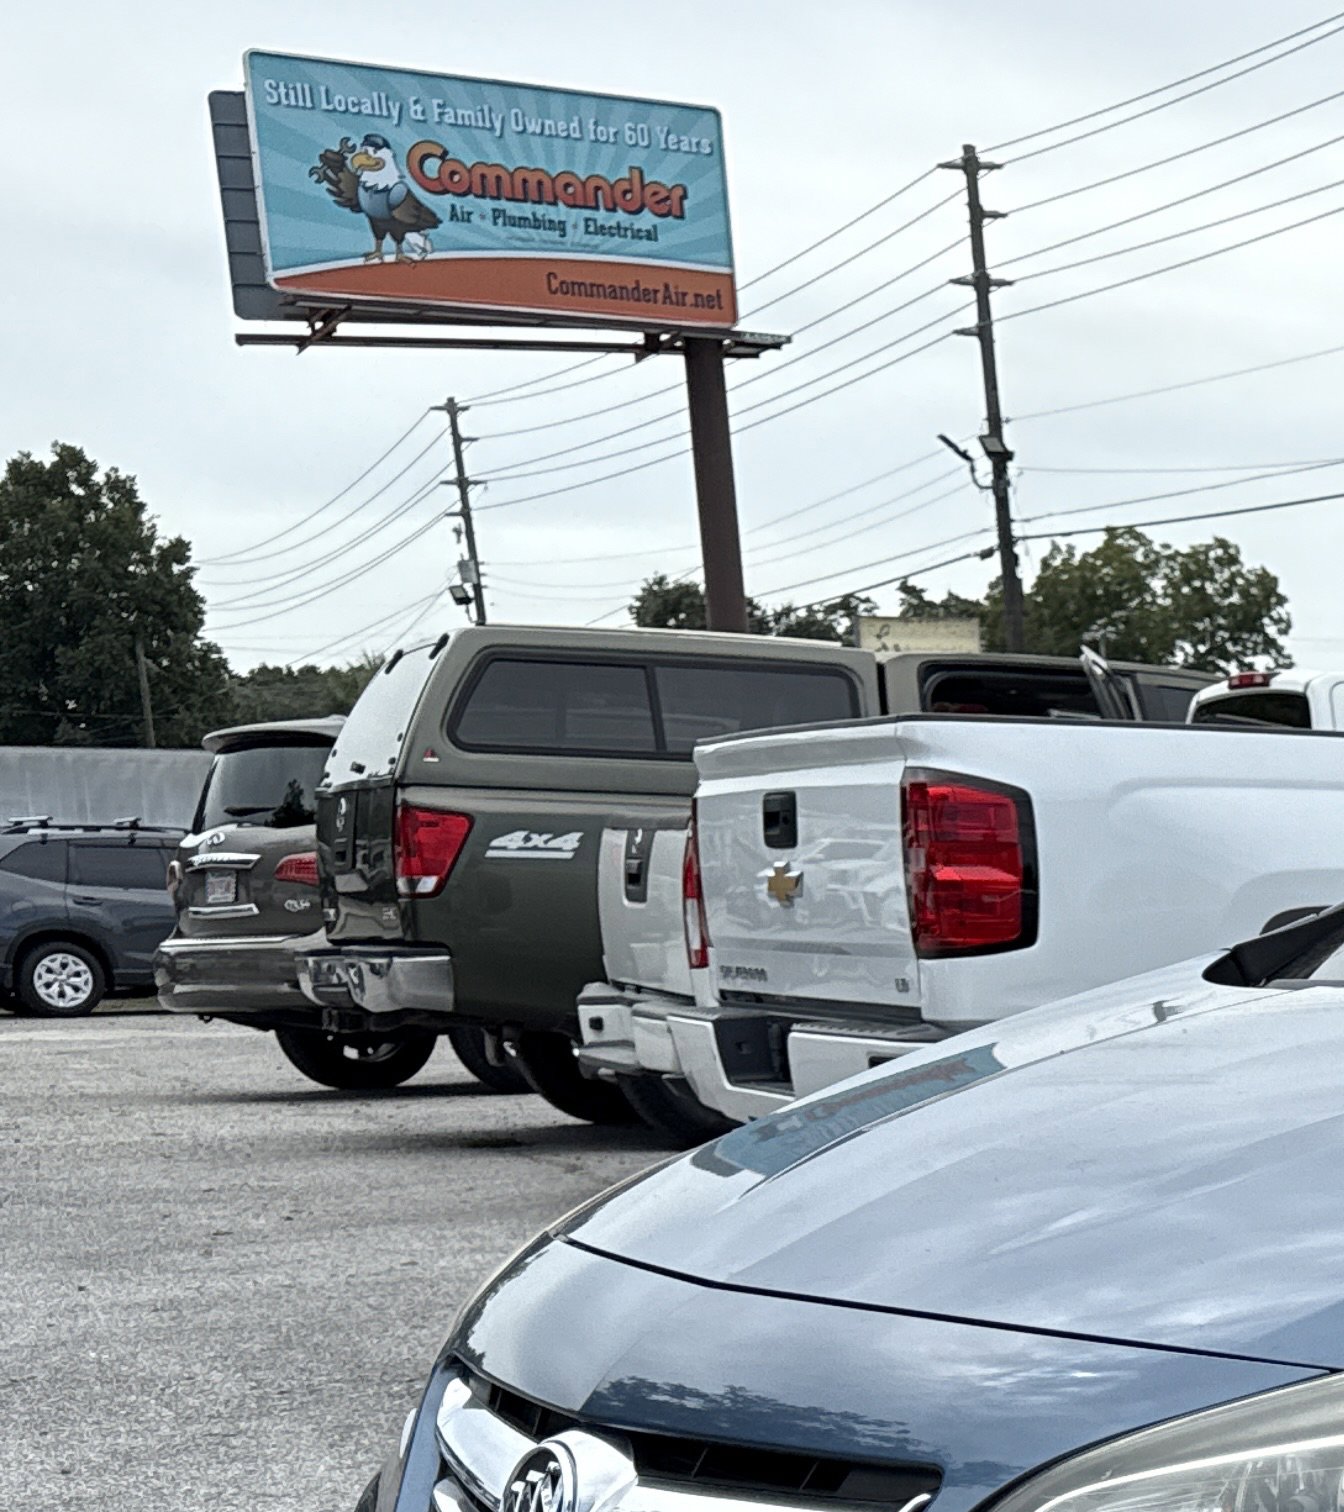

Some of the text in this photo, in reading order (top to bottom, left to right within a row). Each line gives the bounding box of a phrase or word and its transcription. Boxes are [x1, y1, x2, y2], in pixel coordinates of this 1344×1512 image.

[264, 79, 714, 155] Still Locally & Family Owned for 60 Years
[406, 139, 688, 220] Commander
[449, 204, 660, 242] Air Plumbing Electrical
